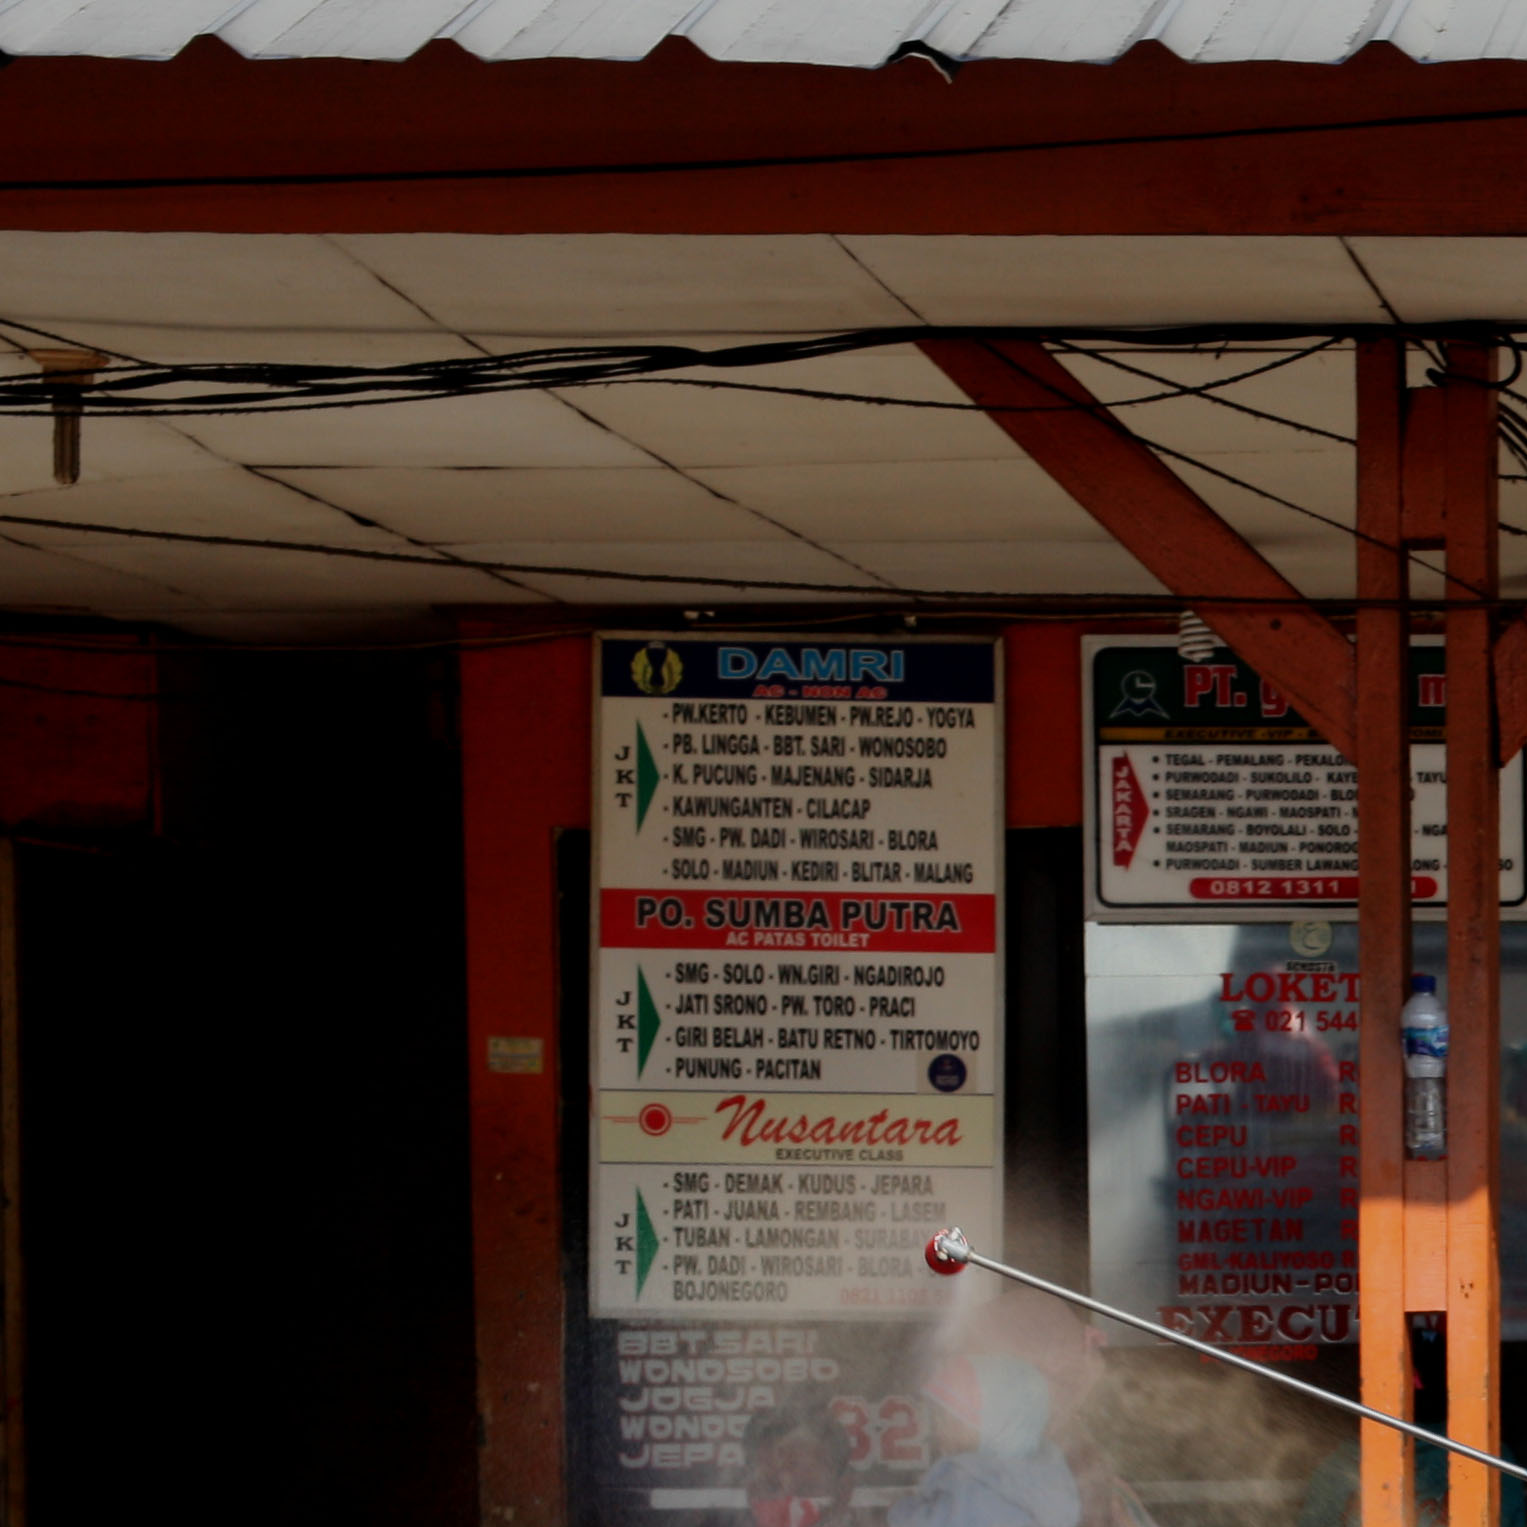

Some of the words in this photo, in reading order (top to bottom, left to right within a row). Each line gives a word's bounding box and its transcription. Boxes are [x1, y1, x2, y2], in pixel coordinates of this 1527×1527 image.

[715, 646, 907, 683] DAMRI
[1182, 663, 1248, 708] PT.
[672, 704, 747, 725] PW.KERTO
[764, 704, 837, 726] KEBUMEN
[849, 706, 913, 727] PW.REJO
[927, 707, 975, 728] YOGYA
[672, 734, 697, 755] PB.
[702, 735, 759, 755] LINGGA
[773, 735, 807, 756] BBT.
[810, 736, 845, 757] SARI
[859, 737, 947, 758] WONOSOBO
[1166, 754, 1206, 766] TEGAL
[1216, 755, 1285, 766] PEMALANG
[672, 765, 689, 785] K.
[693, 765, 757, 786] PUCUNG
[771, 766, 855, 787] MAJENANG
[868, 767, 932, 788] SIDARJA
[672, 796, 792, 818] KAWUNGANTEN
[806, 797, 870, 819] CILACAP
[1166, 807, 1216, 818] SRAGEN
[672, 859, 710, 880] SOLO
[722, 859, 778, 880] MADIUN
[791, 860, 839, 881] KEDIRI
[851, 861, 901, 882] BLITAR
[914, 863, 973, 884] MALANG
[1209, 880, 1274, 896] 0812
[1281, 880, 1340, 896] 1311
[636, 897, 695, 929] PO.
[705, 898, 829, 931] SUMBA
[842, 900, 962, 933] PUTRA
[725, 932, 750, 946] AC
[753, 932, 807, 947] PATAS
[810, 932, 870, 948] TOILET
[675, 963, 709, 984] SMG
[722, 964, 764, 985] SOLO
[777, 965, 840, 986] WN.GIRI
[853, 966, 945, 987] NGADIROJO
[1264, 1011, 1307, 1032] 021
[675, 1027, 707, 1047] GIRI
[712, 1028, 764, 1048] BELAH
[778, 1029, 818, 1049] BATU
[823, 1029, 876, 1049] RETNO
[890, 1030, 980, 1050] TIRTOMOYO
[675, 1058, 742, 1079] PUNUNG
[755, 1059, 822, 1080] PACITAN
[1175, 1062, 1267, 1084] BLORA
[1176, 1094, 1231, 1115] PATI
[1256, 1094, 1309, 1113] TAYU
[715, 1094, 965, 1146] Nusantara
[1176, 1125, 1248, 1147] CEPU
[775, 1148, 854, 1161] EXECUTIVE
[858, 1149, 904, 1161] CLASS
[1176, 1157, 1297, 1179] CEPU-VIP
[672, 1172, 710, 1194] SMG
[723, 1173, 784, 1195] DEMAK
[798, 1174, 857, 1196] KUDUS
[870, 1174, 934, 1196] JEPARA
[1177, 1187, 1313, 1210] NGAWI-VIP
[1178, 1219, 1304, 1243] MAGETAN
[672, 1281, 788, 1302] BOJONEGORO
